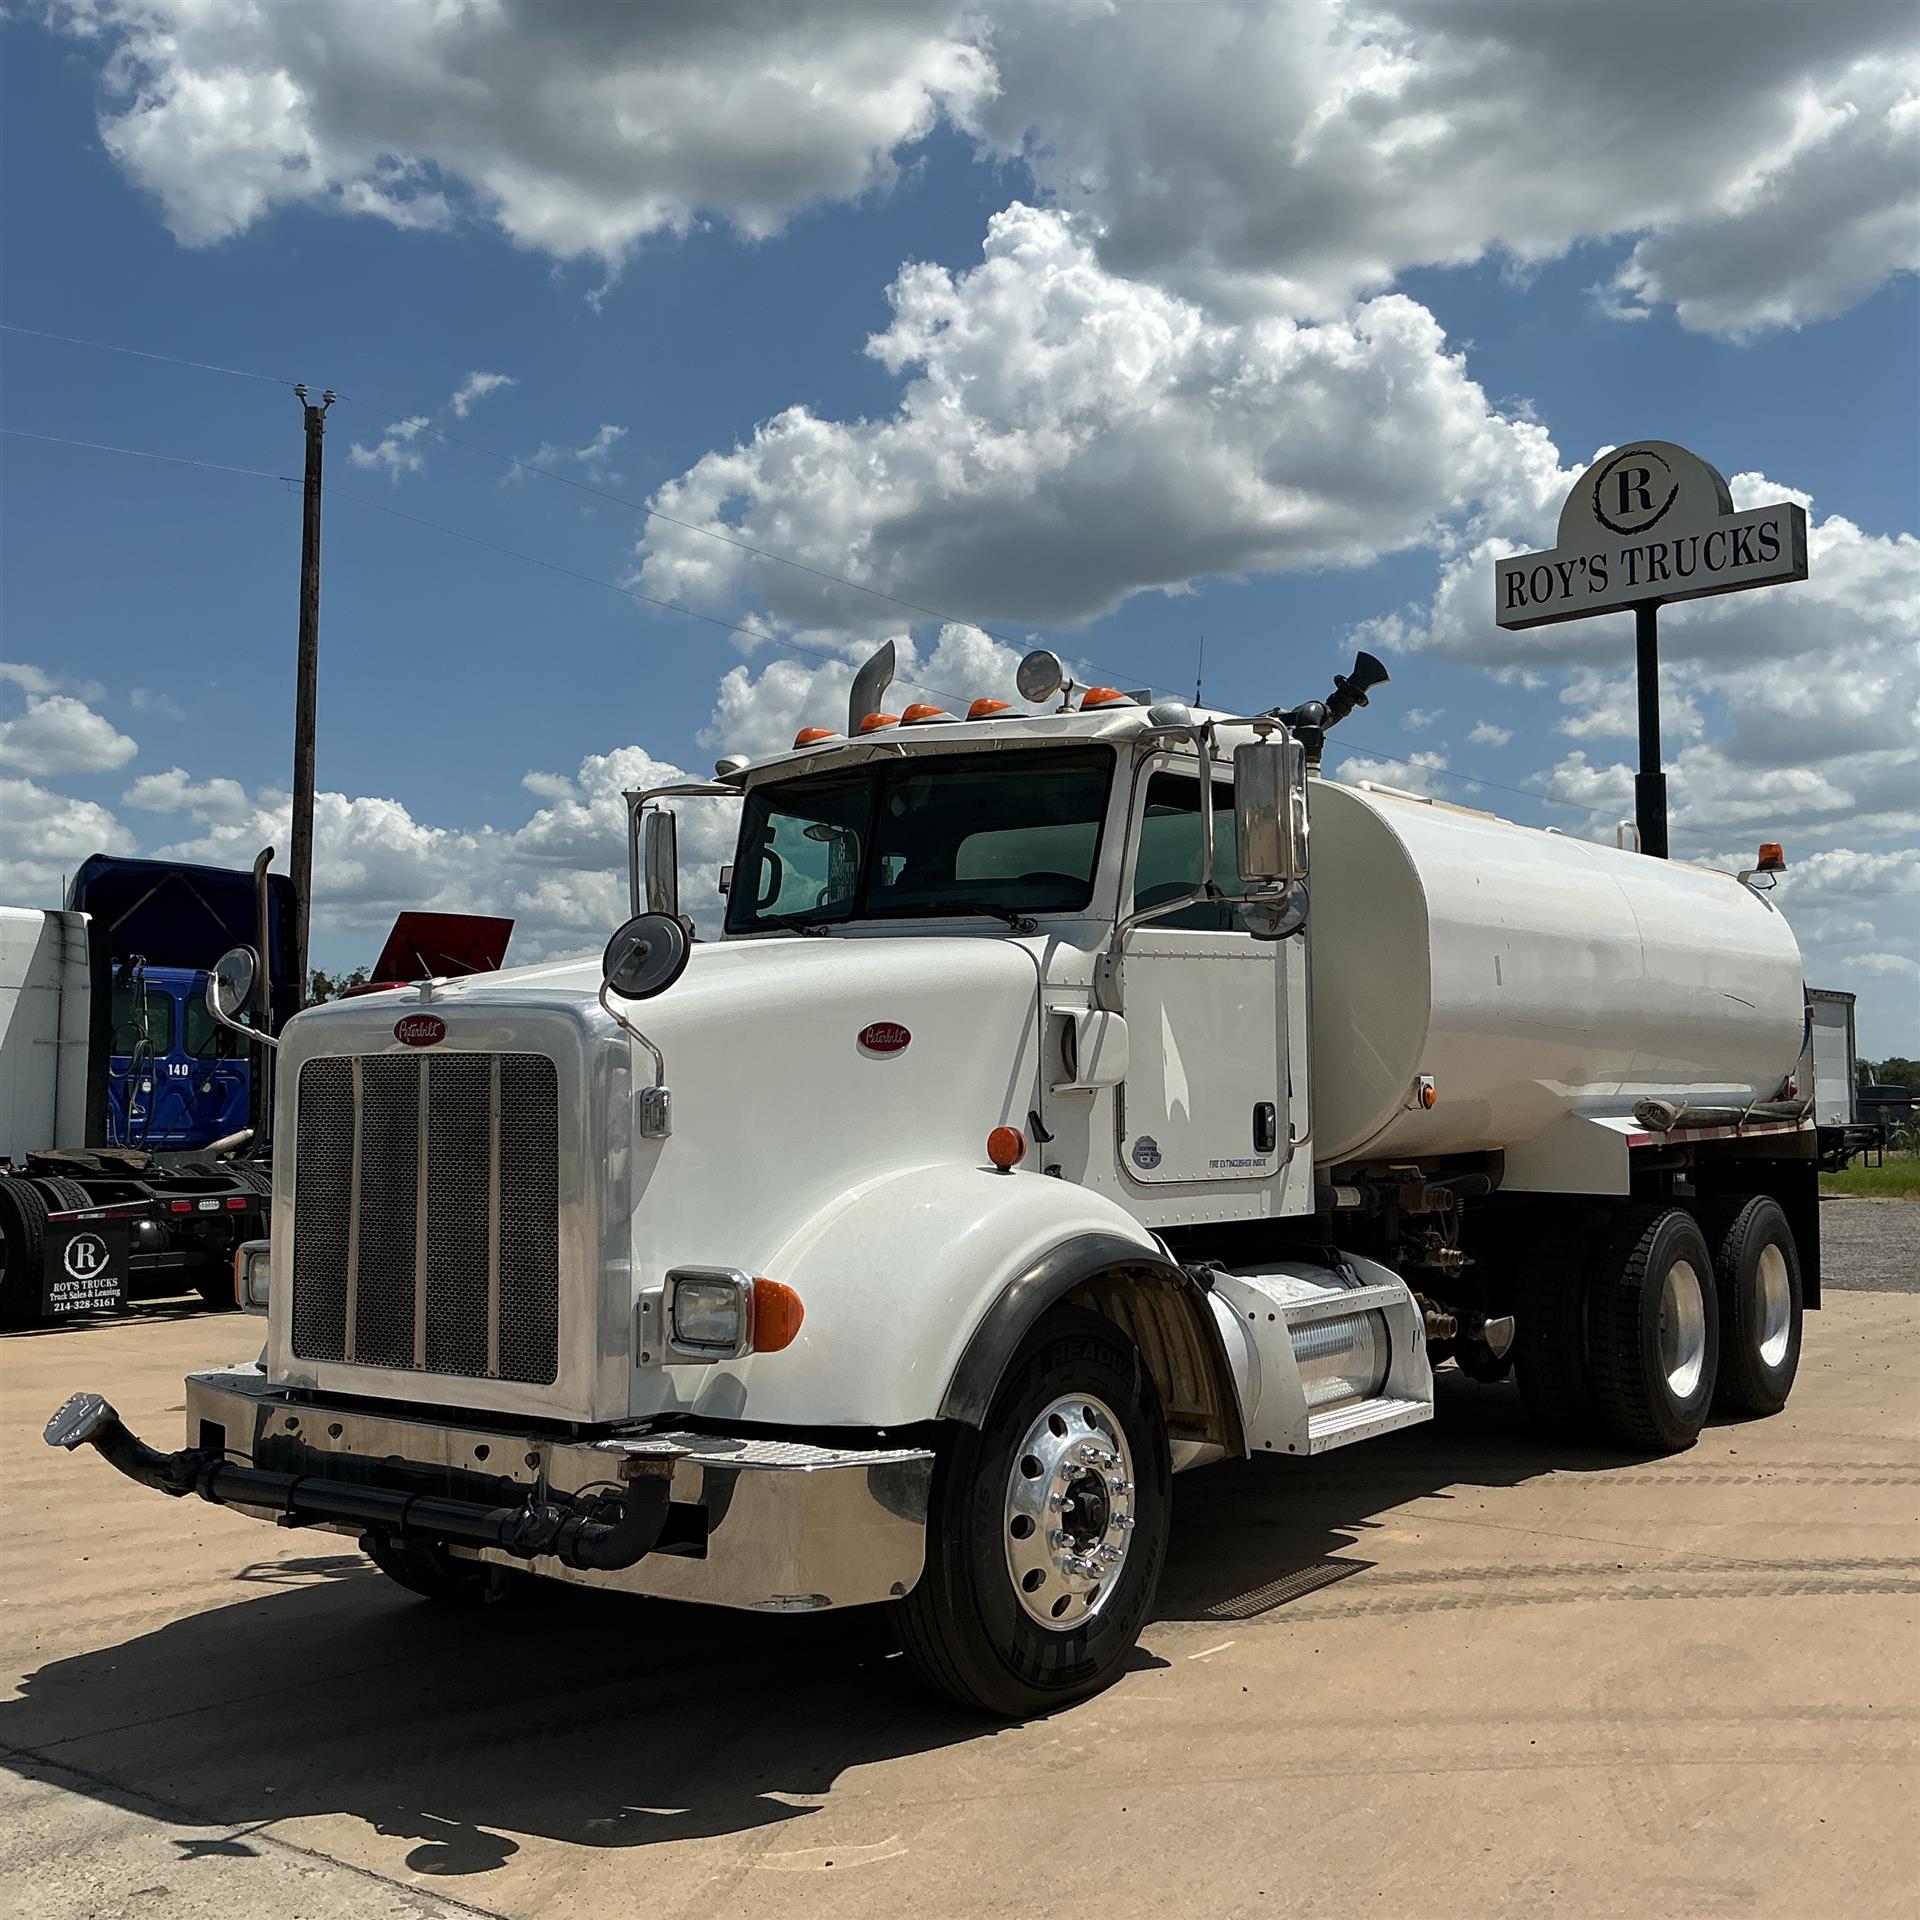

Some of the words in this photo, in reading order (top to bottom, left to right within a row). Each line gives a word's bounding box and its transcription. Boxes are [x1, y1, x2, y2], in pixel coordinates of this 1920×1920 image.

[1614, 467, 1656, 516] R
[1504, 553, 1609, 610] ROY'S
[1620, 520, 1782, 587] TRUCKS
[866, 1026, 907, 1045] Peterbilt
[168, 1063, 189, 1076] 140
[75, 1242, 98, 1269] R
[53, 1281, 80, 1292] ROY'S
[81, 1278, 118, 1290] TRUCKS
[49, 1291, 68, 1302] Truck
[69, 1290, 87, 1300] Sales
[87, 1289, 94, 1298] &
[94, 1287, 121, 1297] Leasing
[54, 1298, 115, 1311] 214-328-5161
